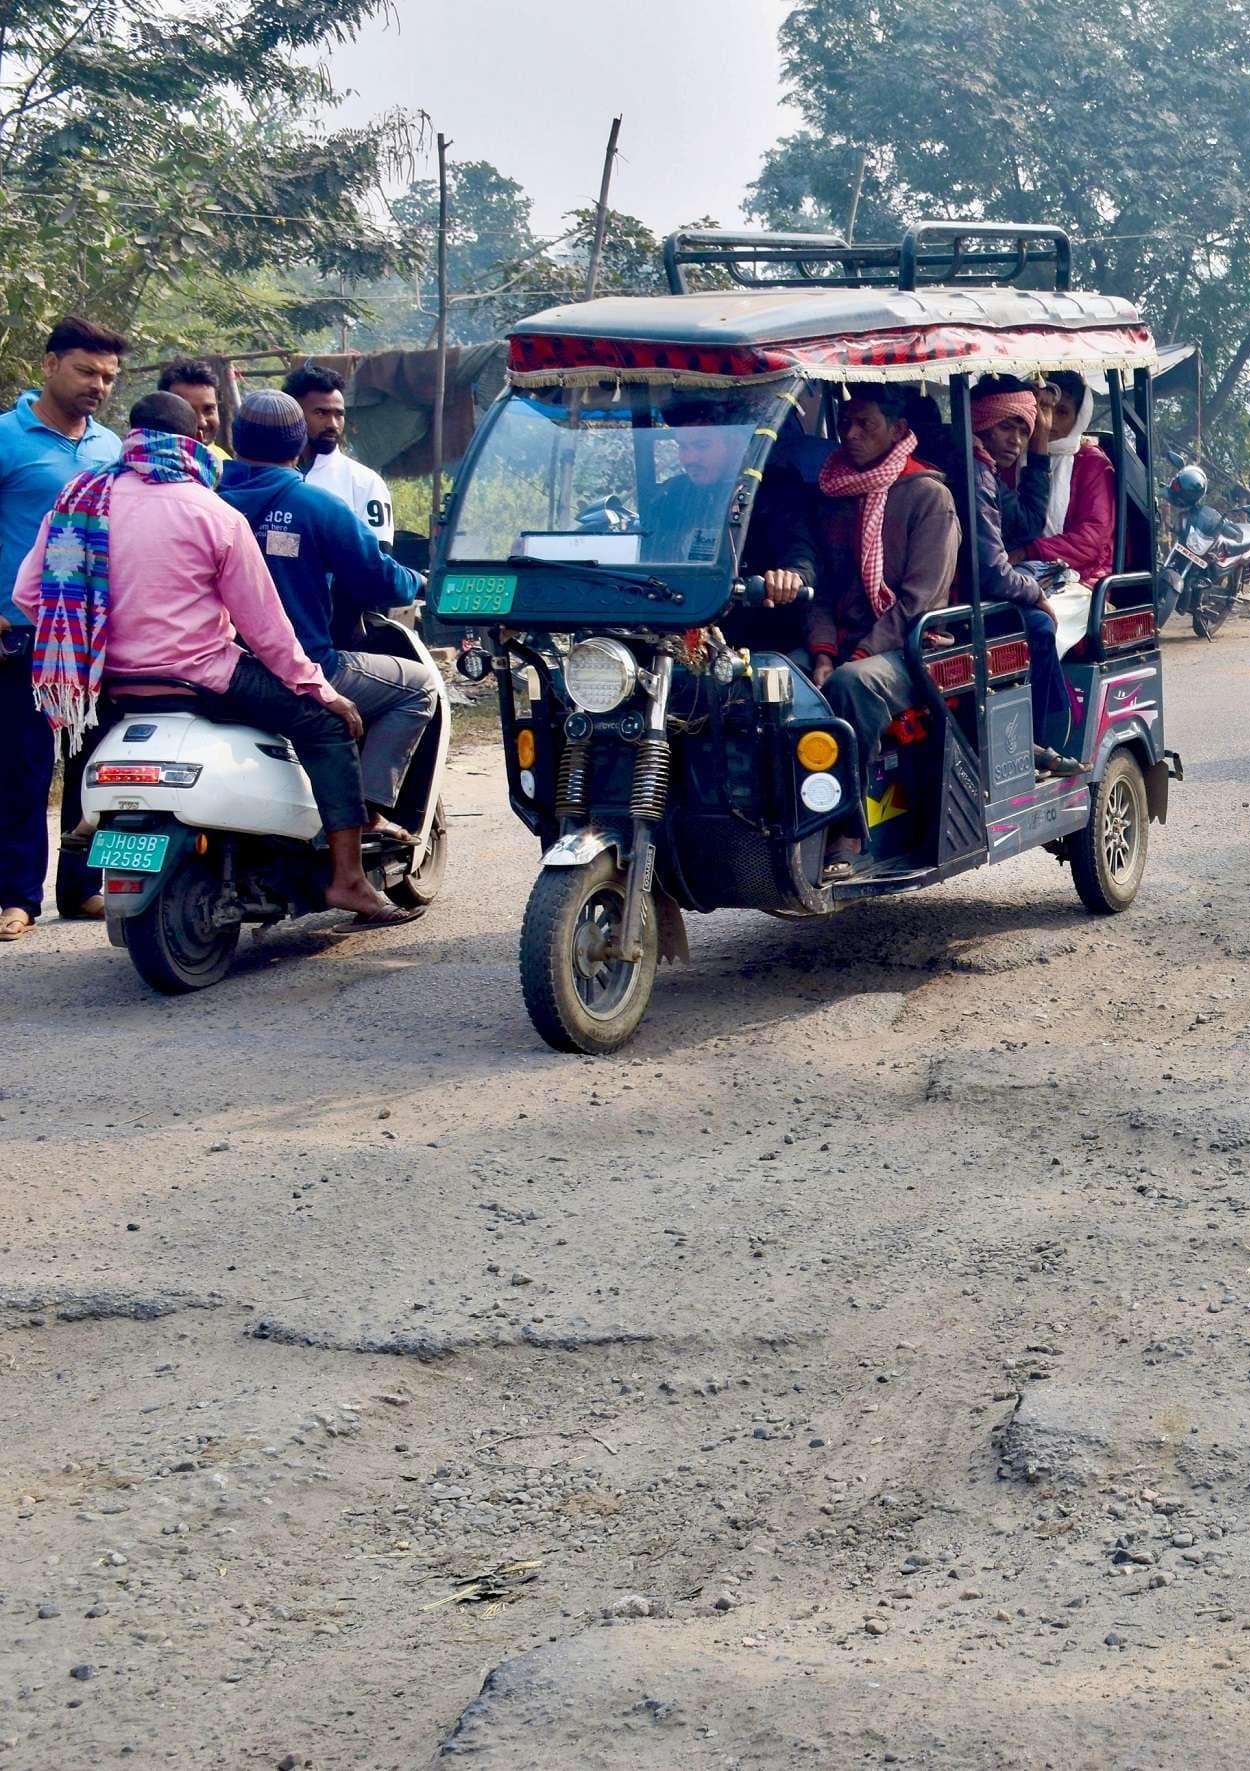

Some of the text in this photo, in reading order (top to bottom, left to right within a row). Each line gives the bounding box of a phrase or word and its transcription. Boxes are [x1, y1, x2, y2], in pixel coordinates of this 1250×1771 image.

[455, 578, 506, 593] JH09B
[451, 595, 502, 611] J1979
[105, 834, 158, 851] JH09B
[100, 851, 153, 868] H2585
